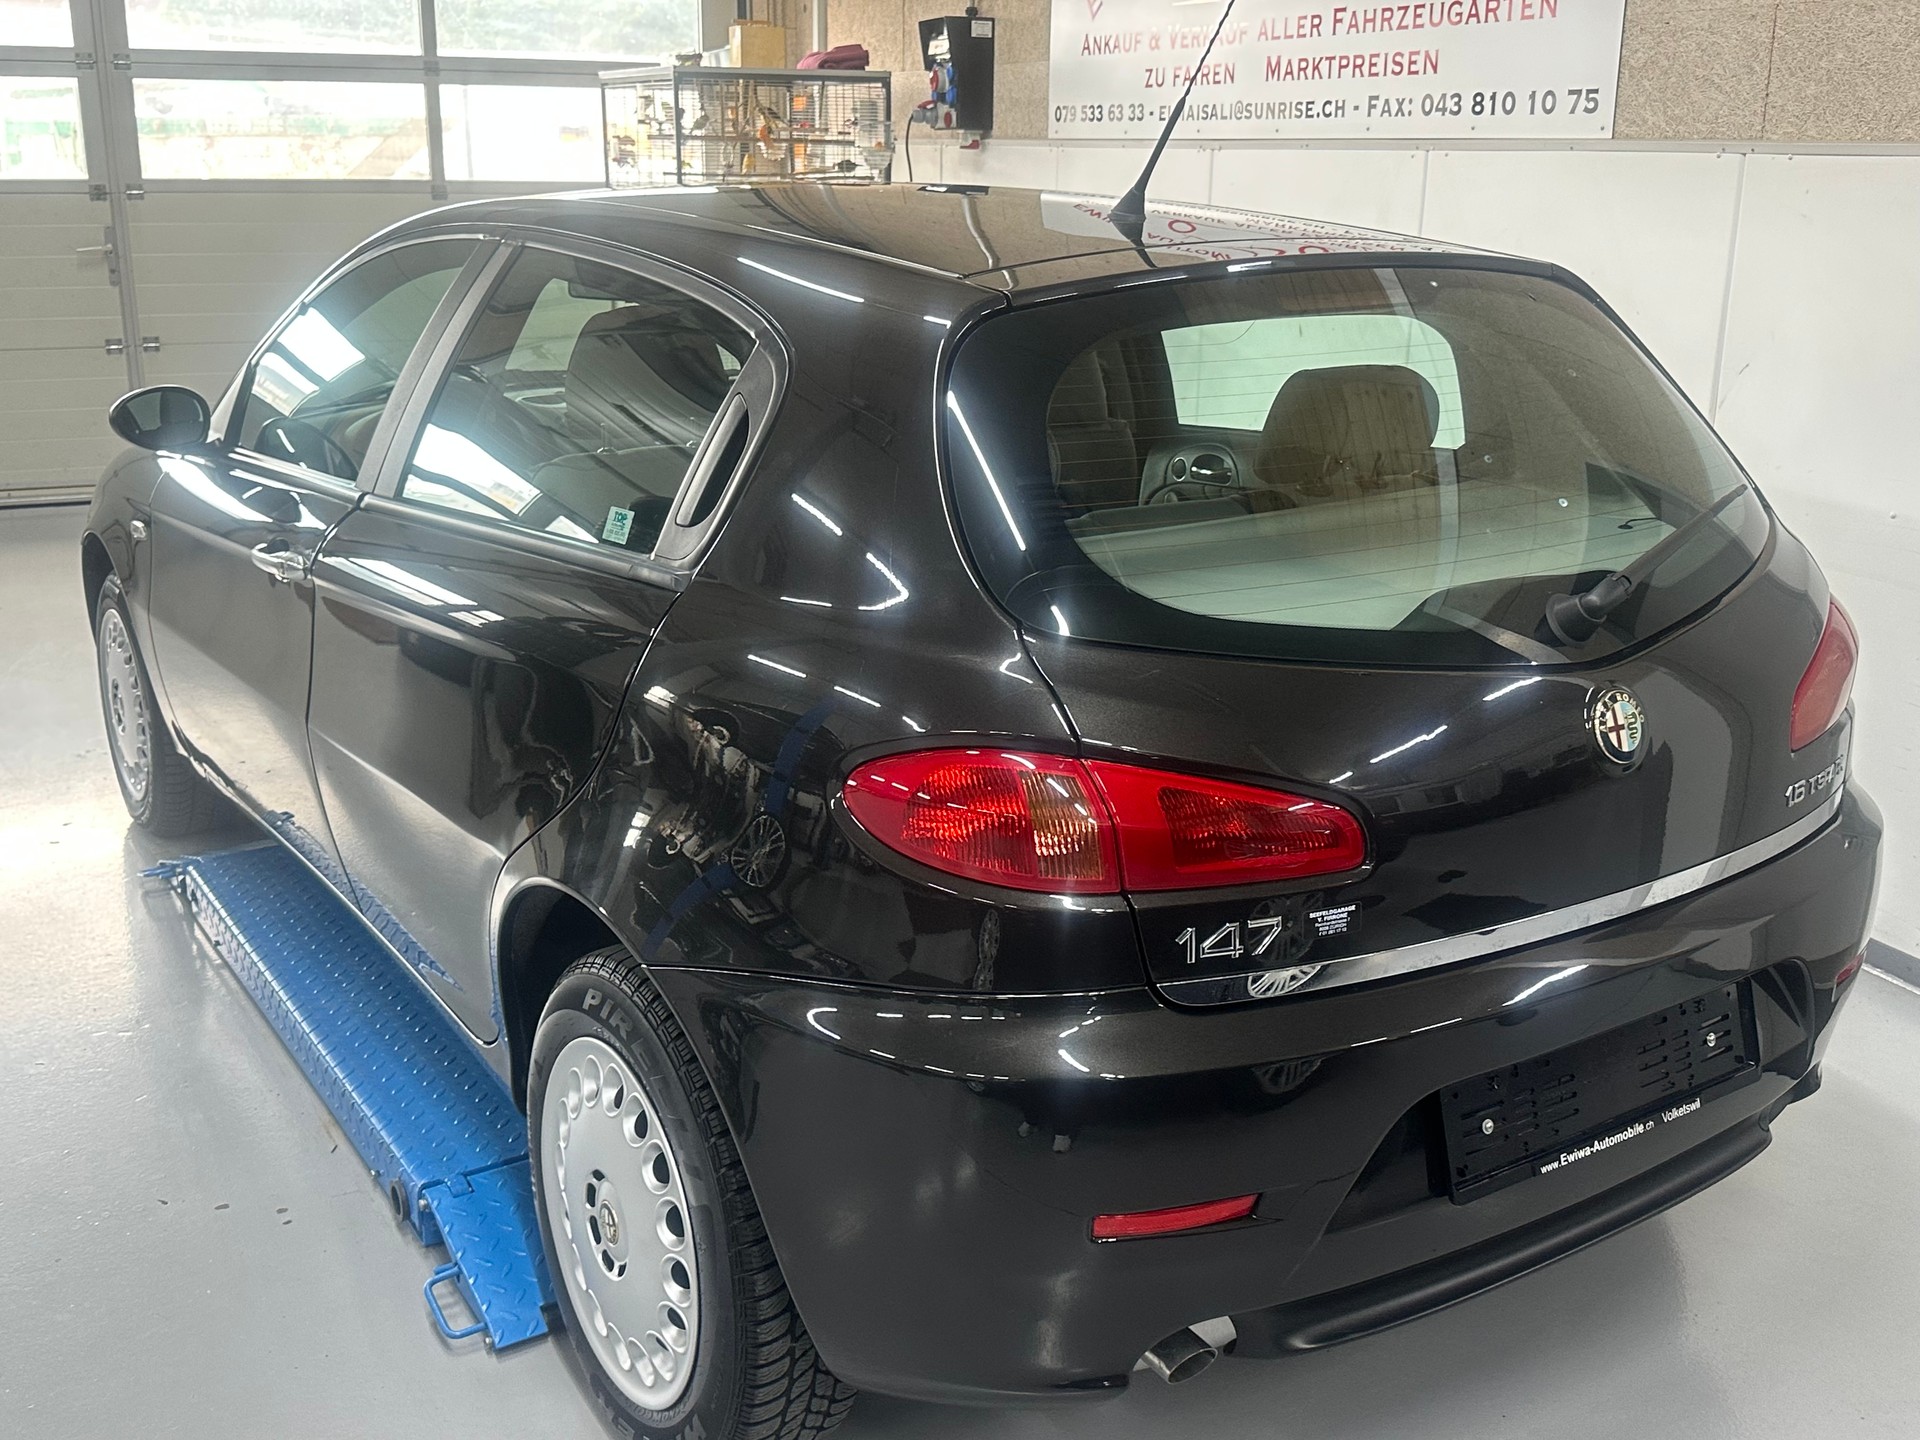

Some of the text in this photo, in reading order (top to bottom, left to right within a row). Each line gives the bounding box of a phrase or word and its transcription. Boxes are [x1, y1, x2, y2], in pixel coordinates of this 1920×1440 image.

[1081, 32, 1143, 56] ANKAUF
[1257, 15, 1322, 42] ALLER
[1332, 0, 1558, 36] FAHRZEUGARTEN
[1144, 68, 1166, 88] ZU
[1265, 49, 1440, 82] MARKTPREISEN
[1055, 105, 1077, 123] 079
[1080, 105, 1103, 122] 533
[1109, 104, 1124, 122] 63
[1128, 103, 1144, 121] 33
[1421, 92, 1462, 117] 043
[1471, 91, 1516, 116] 810
[1528, 90, 1557, 115] 10
[1567, 88, 1600, 114] 75
[1175, 915, 1282, 964] 147
[1661, 1097, 1701, 1123] Volketswil
